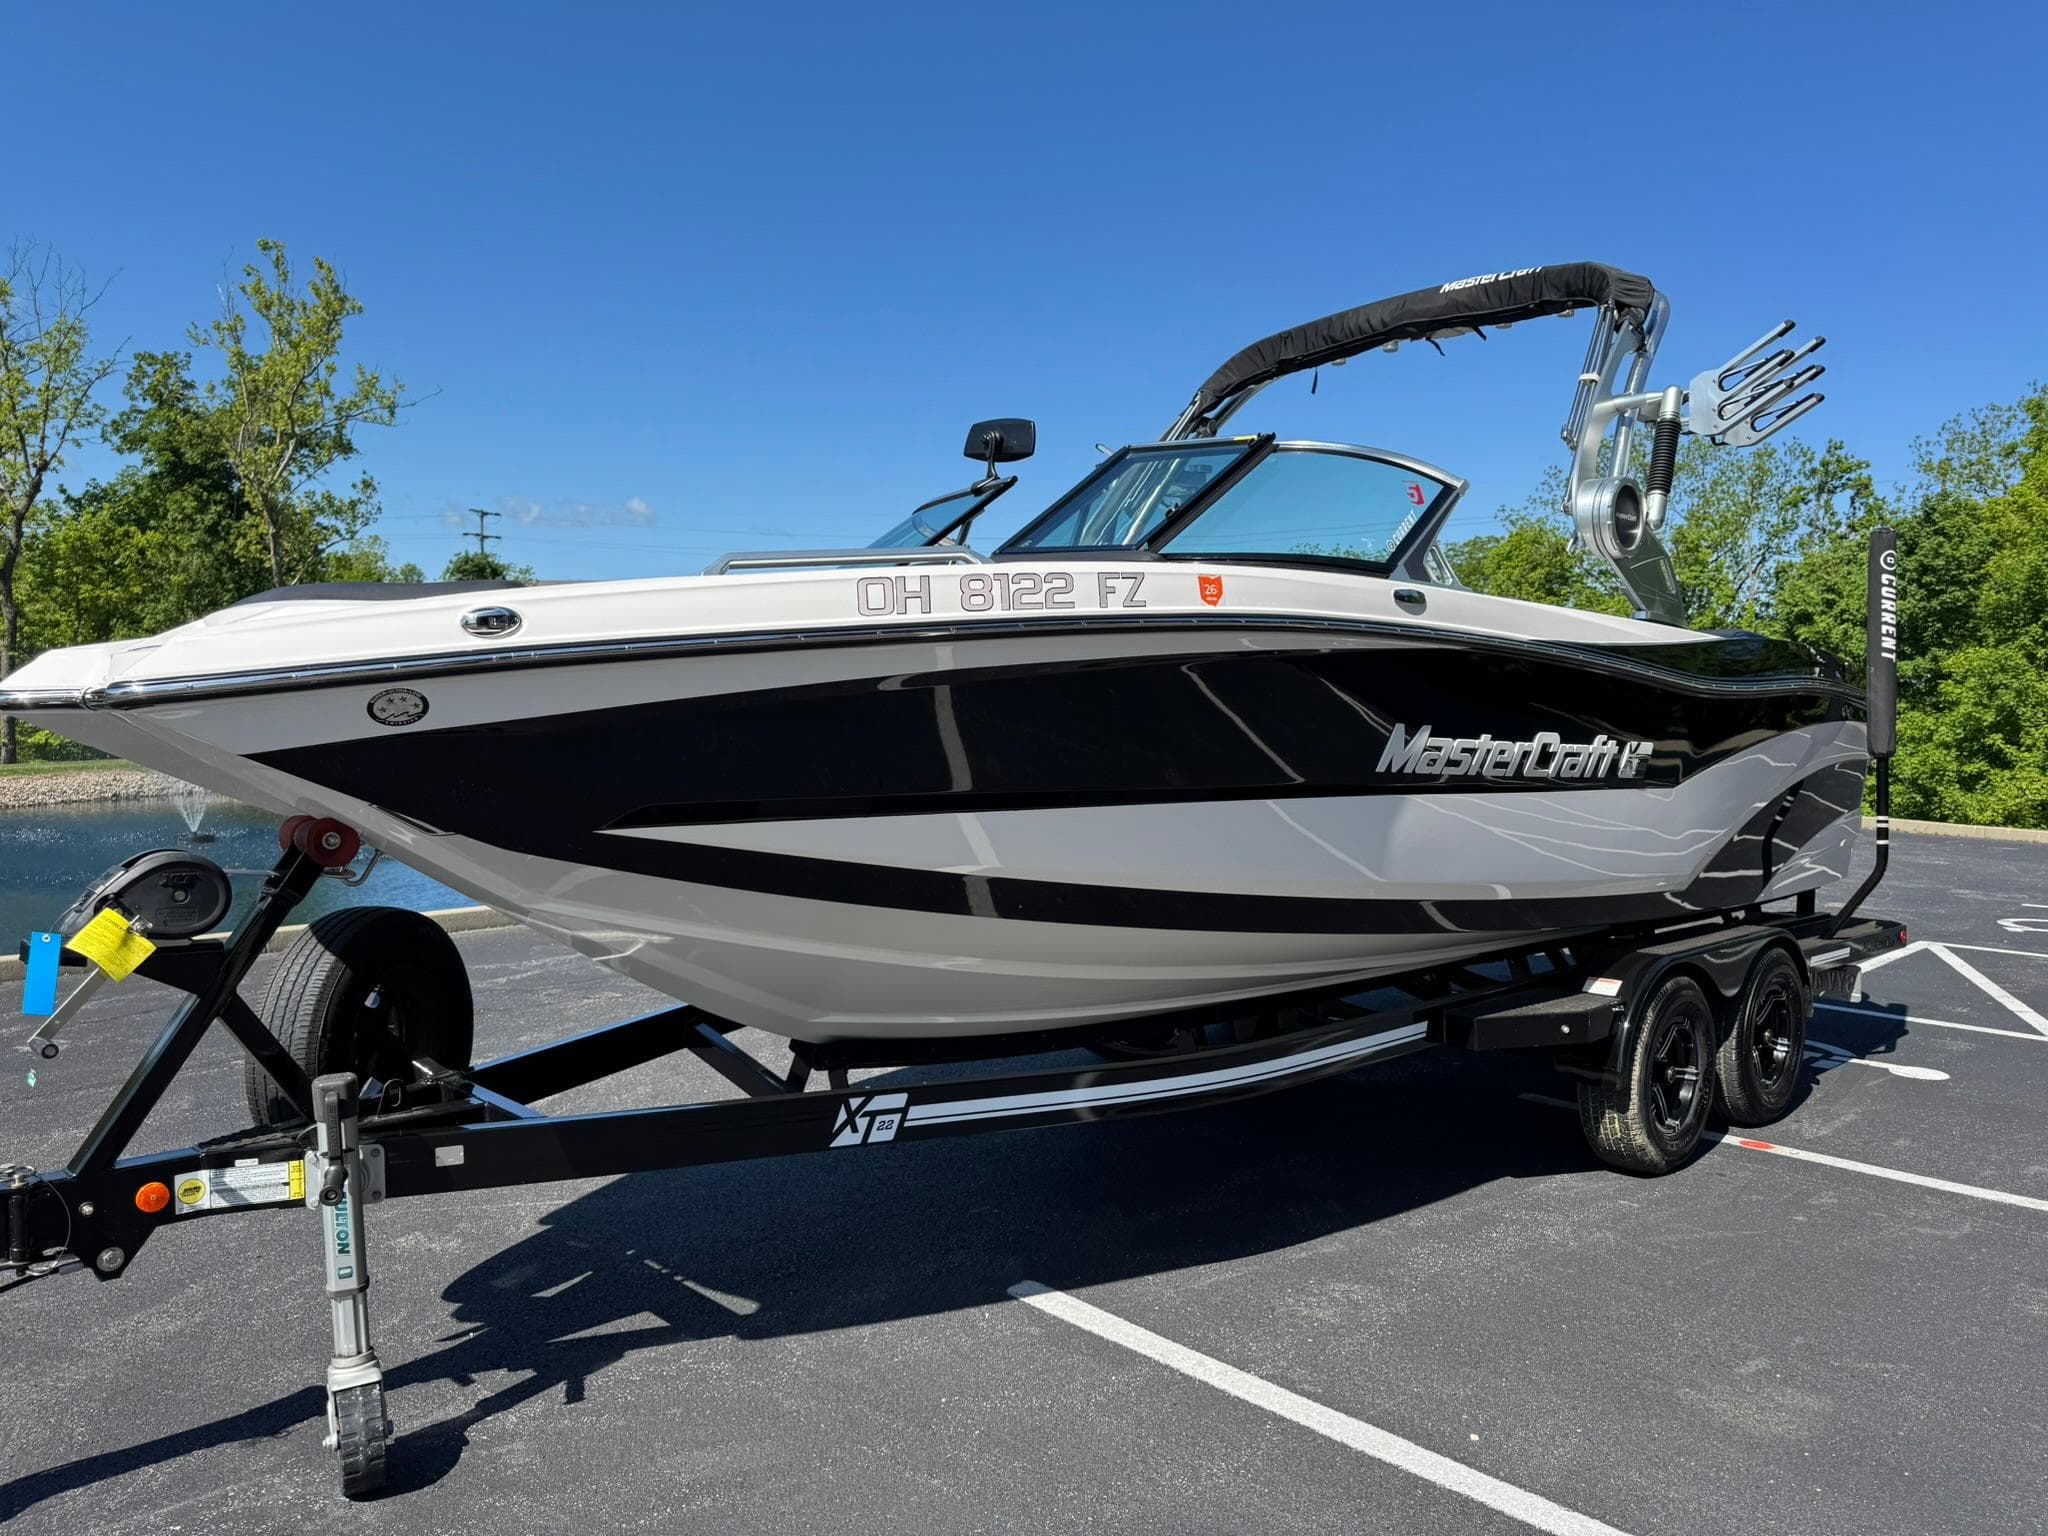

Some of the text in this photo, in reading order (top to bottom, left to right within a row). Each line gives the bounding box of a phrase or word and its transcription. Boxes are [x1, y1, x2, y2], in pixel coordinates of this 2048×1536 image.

[857, 571, 1147, 616] OH 8122 FZ
[1204, 584, 1217, 595] 26
[1881, 573, 1897, 662] CURRENT
[1375, 723, 1617, 779] MasterCraft
[876, 1119, 894, 1131] 22
[334, 1191, 350, 1254] ULTON
